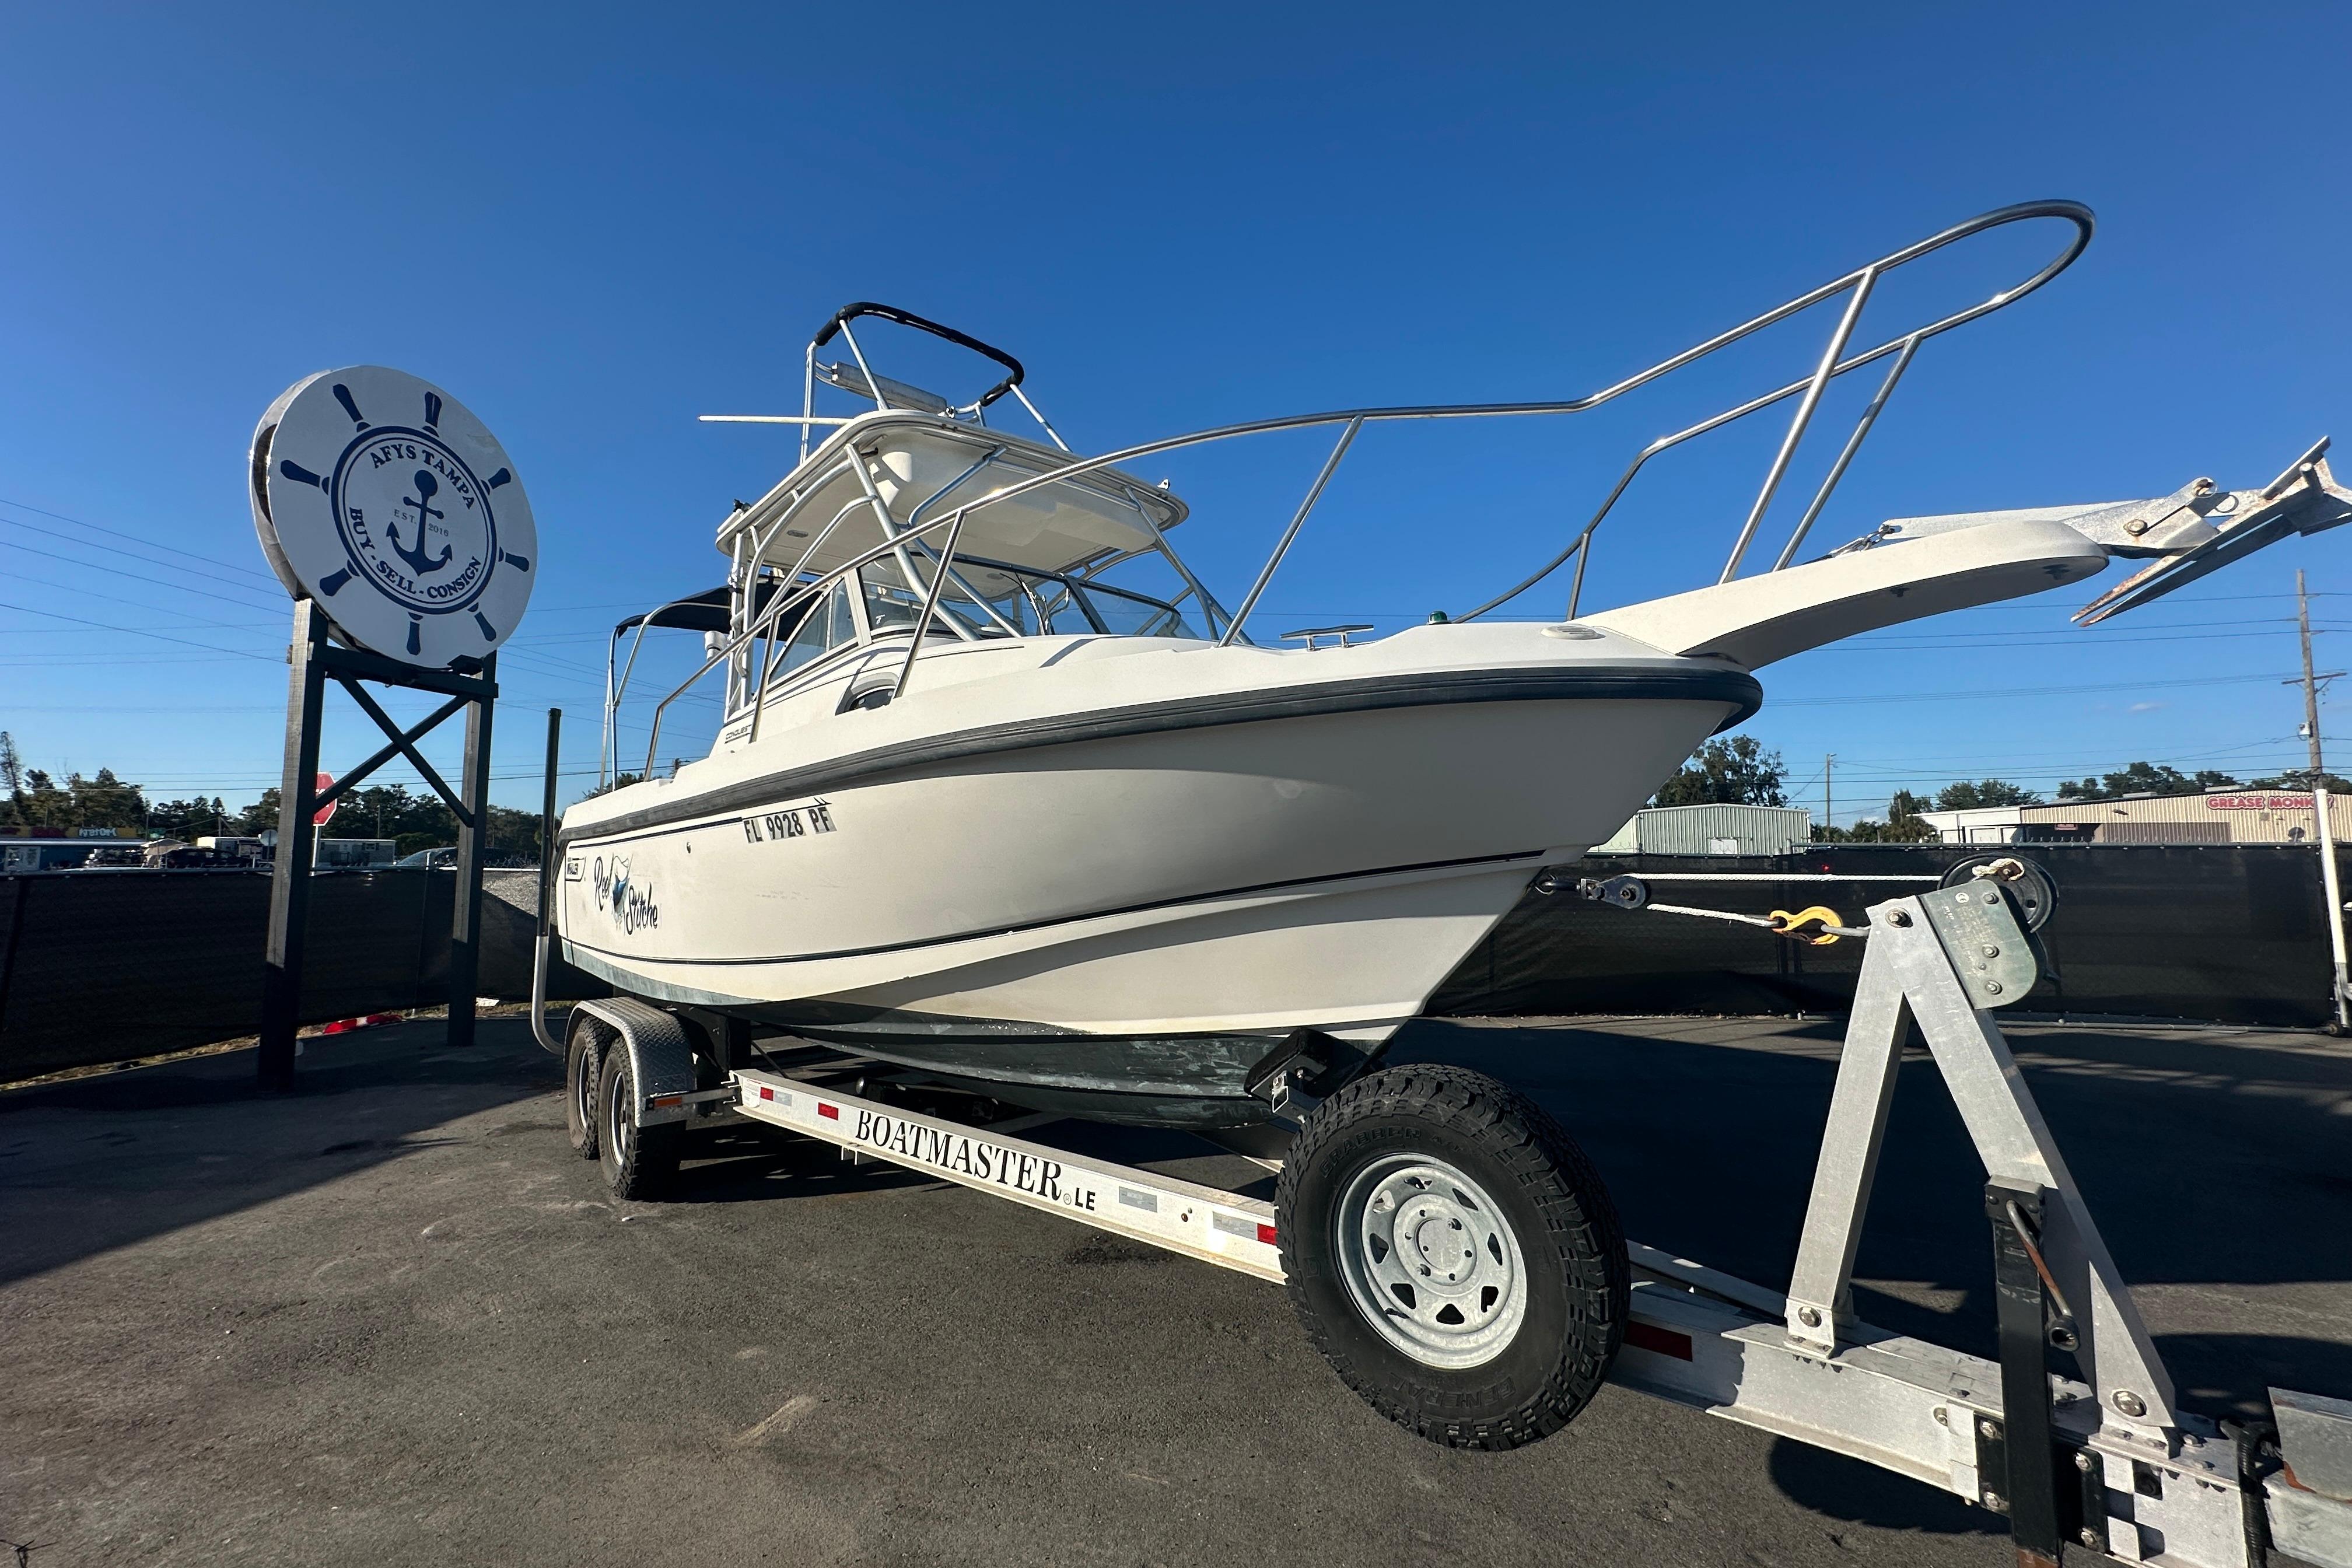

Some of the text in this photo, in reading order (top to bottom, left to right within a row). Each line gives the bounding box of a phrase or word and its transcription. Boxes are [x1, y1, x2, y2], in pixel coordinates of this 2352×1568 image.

[370, 444, 474, 510] AFYS TAMPA
[394, 509, 449, 537] EST. 2016
[349, 507, 375, 550] BUY
[376, 560, 416, 594] SELL
[426, 556, 481, 599] CONSIGN
[2208, 796, 2333, 808] GREASE MONK
[743, 806, 829, 844] FL 9928 PF
[1318, 1126, 1422, 1178] GRABBER
[1074, 1187, 1096, 1211] LE
[1390, 1372, 1517, 1409] GENERAL
